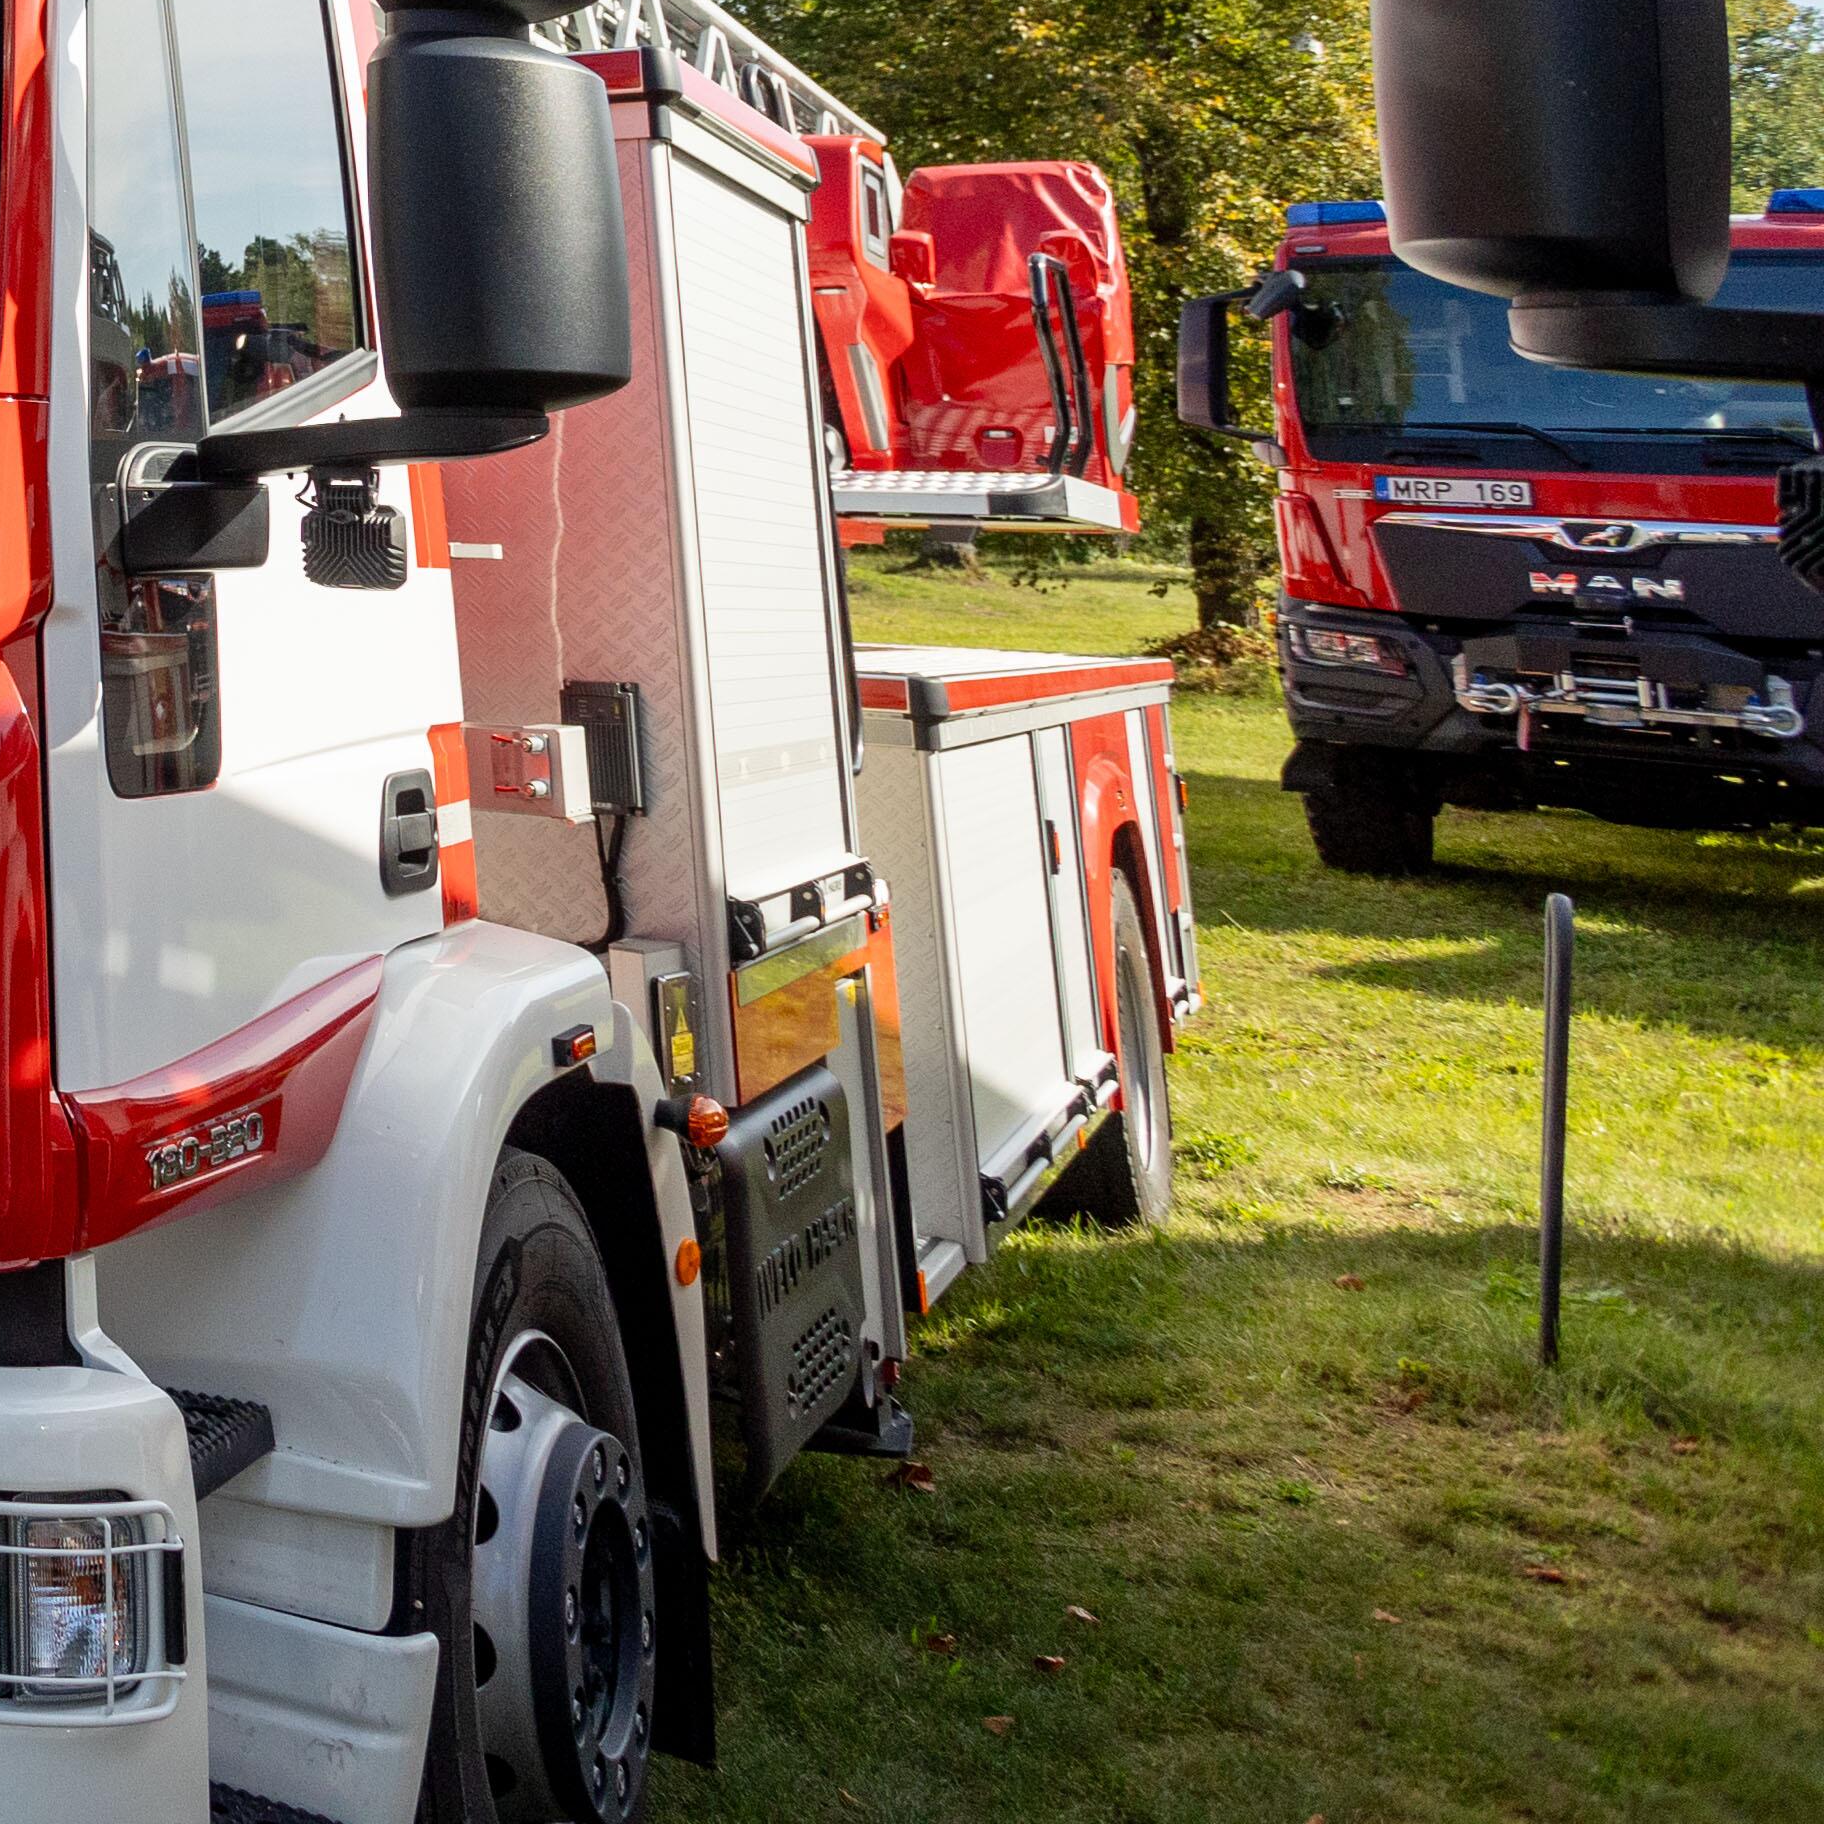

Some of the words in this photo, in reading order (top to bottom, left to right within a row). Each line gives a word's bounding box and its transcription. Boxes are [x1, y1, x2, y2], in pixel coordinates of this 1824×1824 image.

[1393, 480, 1451, 500] MRP
[1476, 483, 1524, 502] 169
[1528, 571, 1684, 600] MAN
